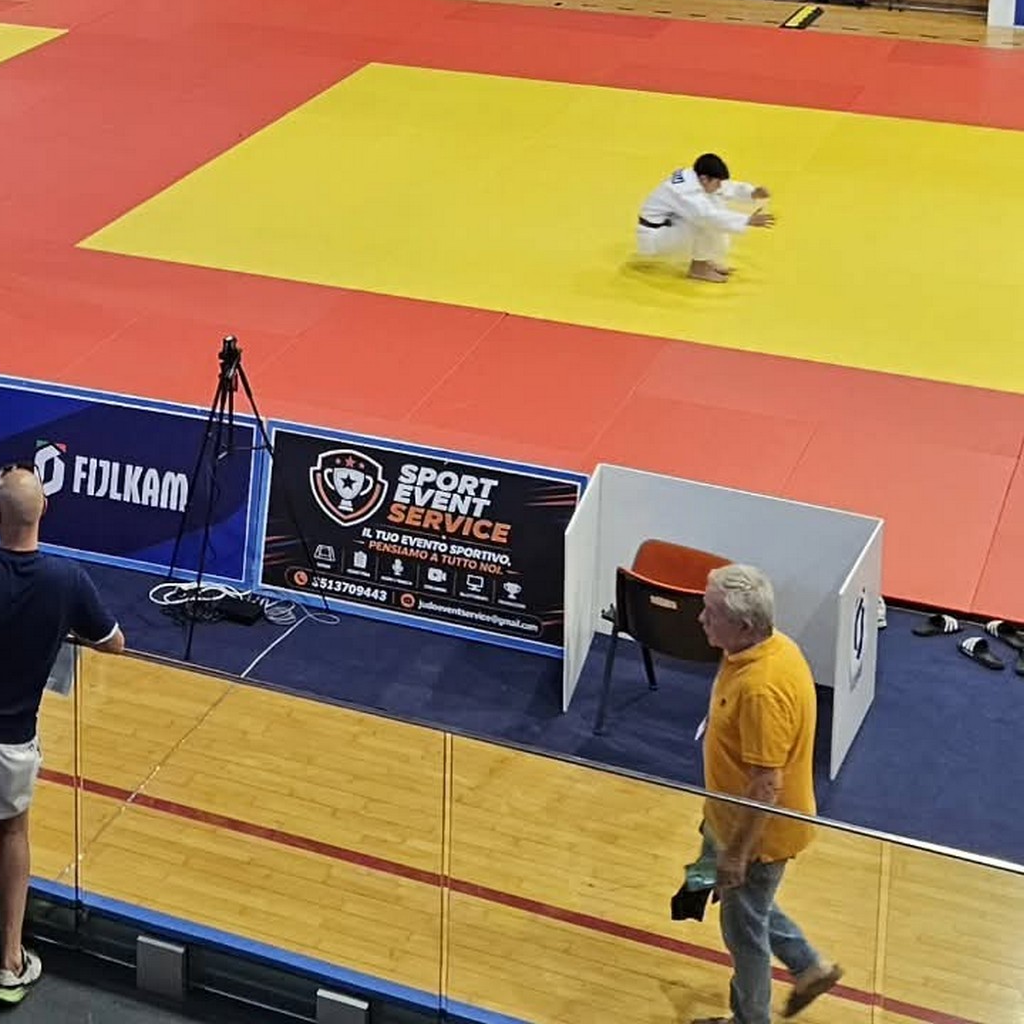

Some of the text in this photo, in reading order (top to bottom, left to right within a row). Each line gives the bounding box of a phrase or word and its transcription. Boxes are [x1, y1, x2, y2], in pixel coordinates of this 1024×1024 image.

[72, 454, 189, 513] FIJLKAM
[397, 463, 499, 499] SPORT
[393, 482, 492, 518] EVENT
[362, 527, 373, 539] IL
[375, 529, 400, 543] TUO
[401, 534, 449, 553] EVENTO
[386, 502, 512, 544] SERVICE
[368, 539, 429, 561] PENSIAMO
[429, 552, 439, 563] A
[441, 553, 477, 570] TUTTO
